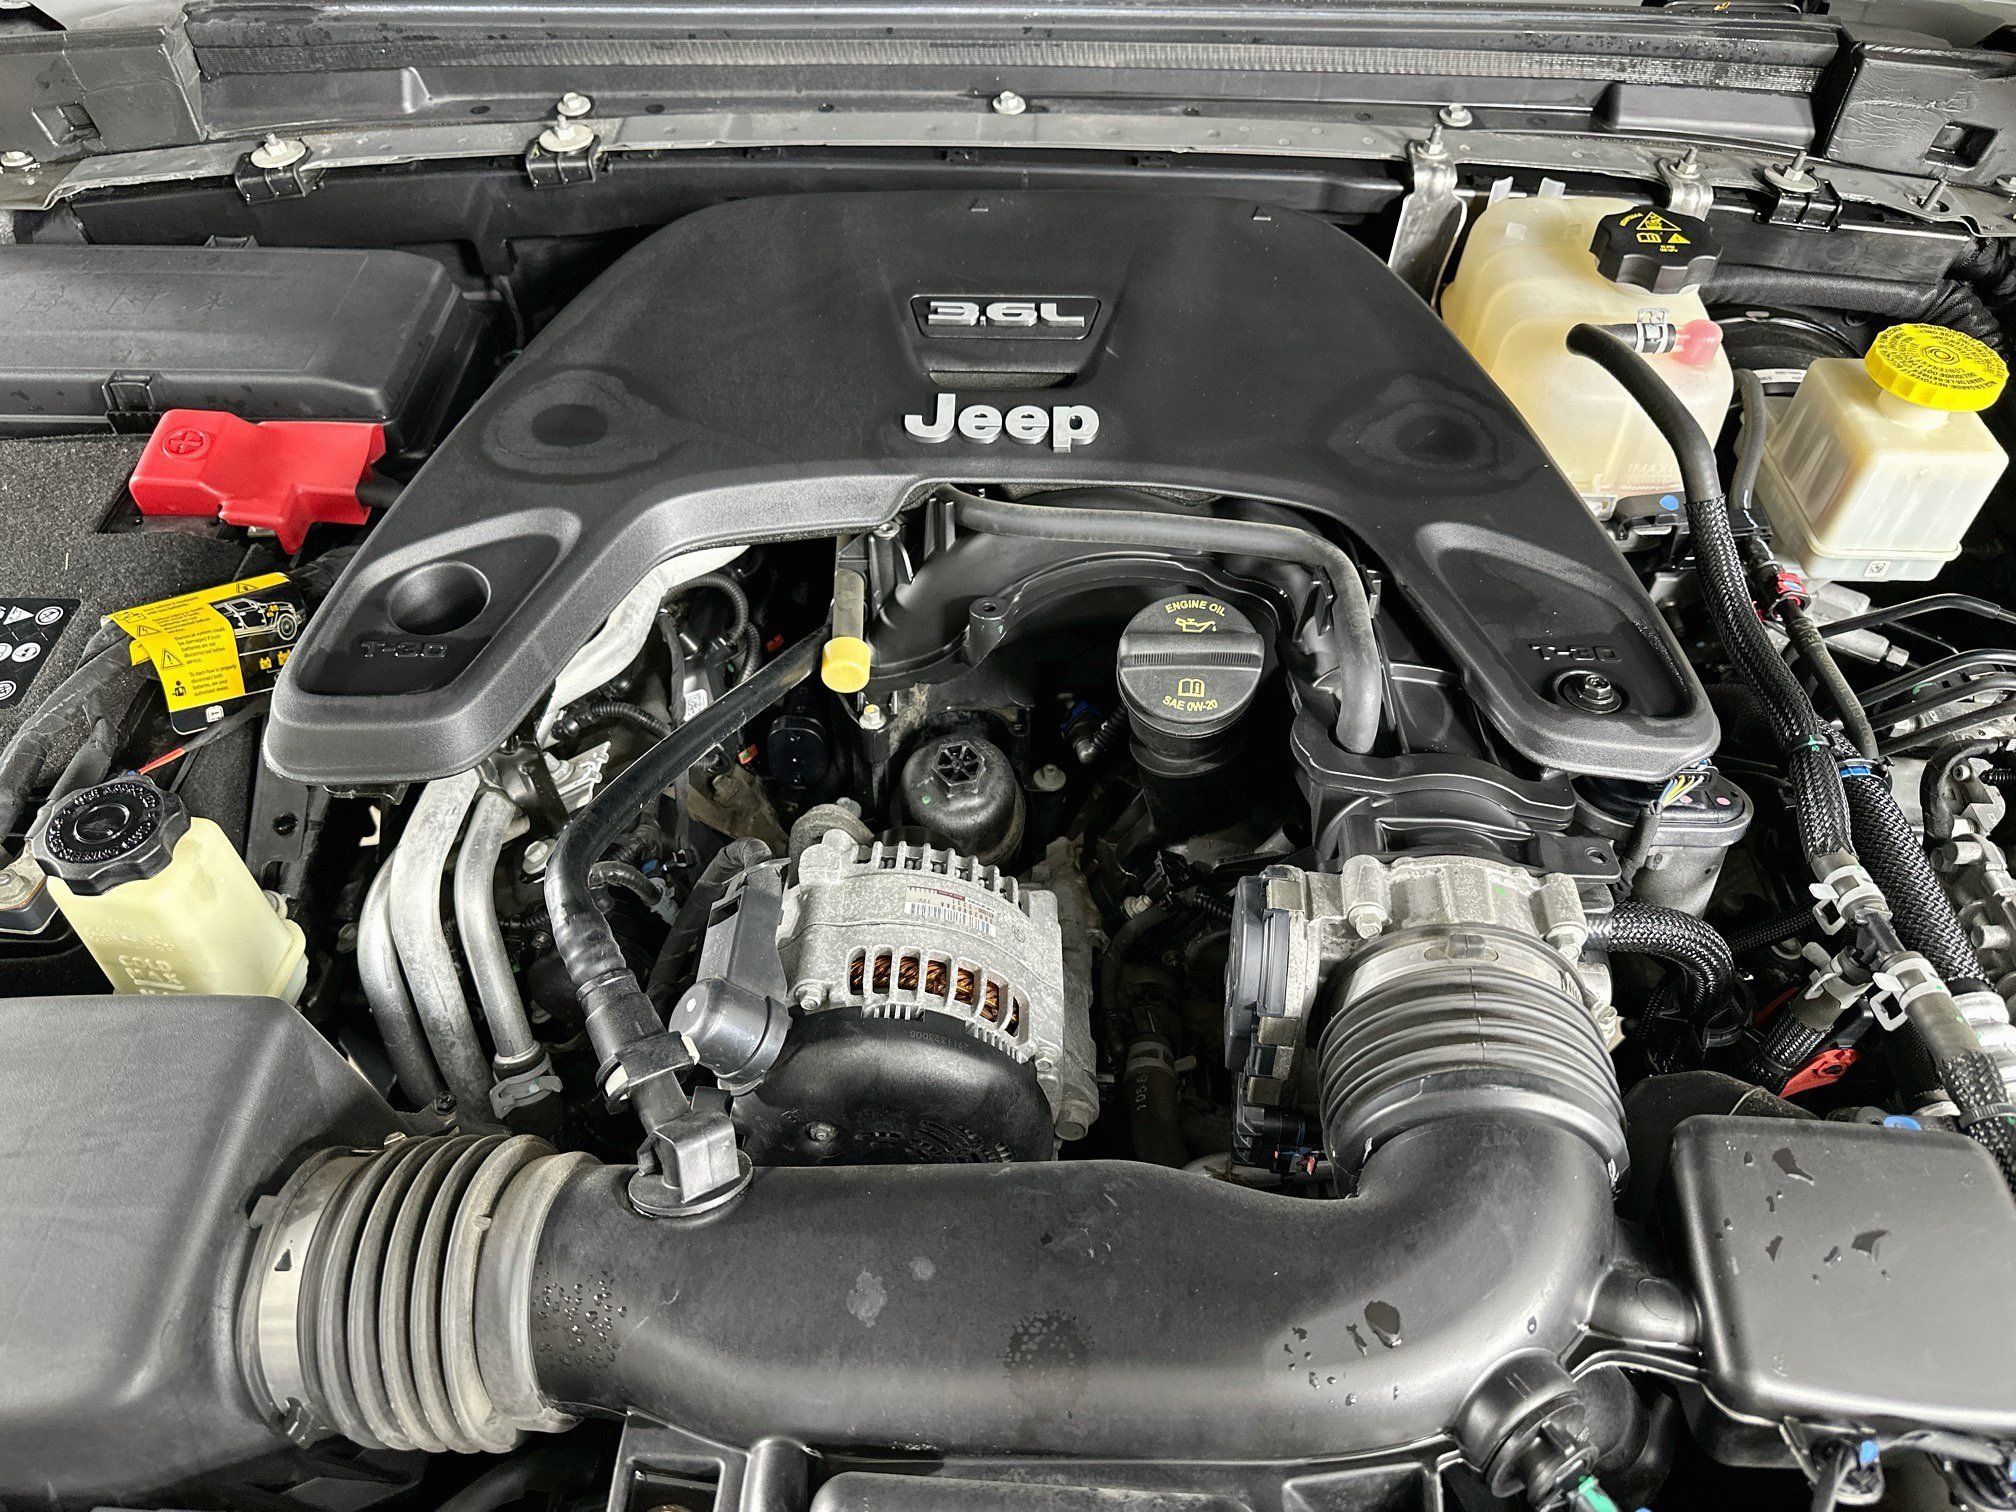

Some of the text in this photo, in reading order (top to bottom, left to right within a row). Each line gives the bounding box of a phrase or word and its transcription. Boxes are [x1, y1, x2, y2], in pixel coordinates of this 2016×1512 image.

[927, 300, 1085, 328] 3.6L
[904, 393, 1100, 454] Jeep
[1165, 599, 1227, 617] ENGINE OIL
[1529, 643, 1623, 663] T-30
[1162, 694, 1219, 712] SAE 0W-20
[118, 954, 172, 972] COLD
[125, 967, 182, 985] MAX
